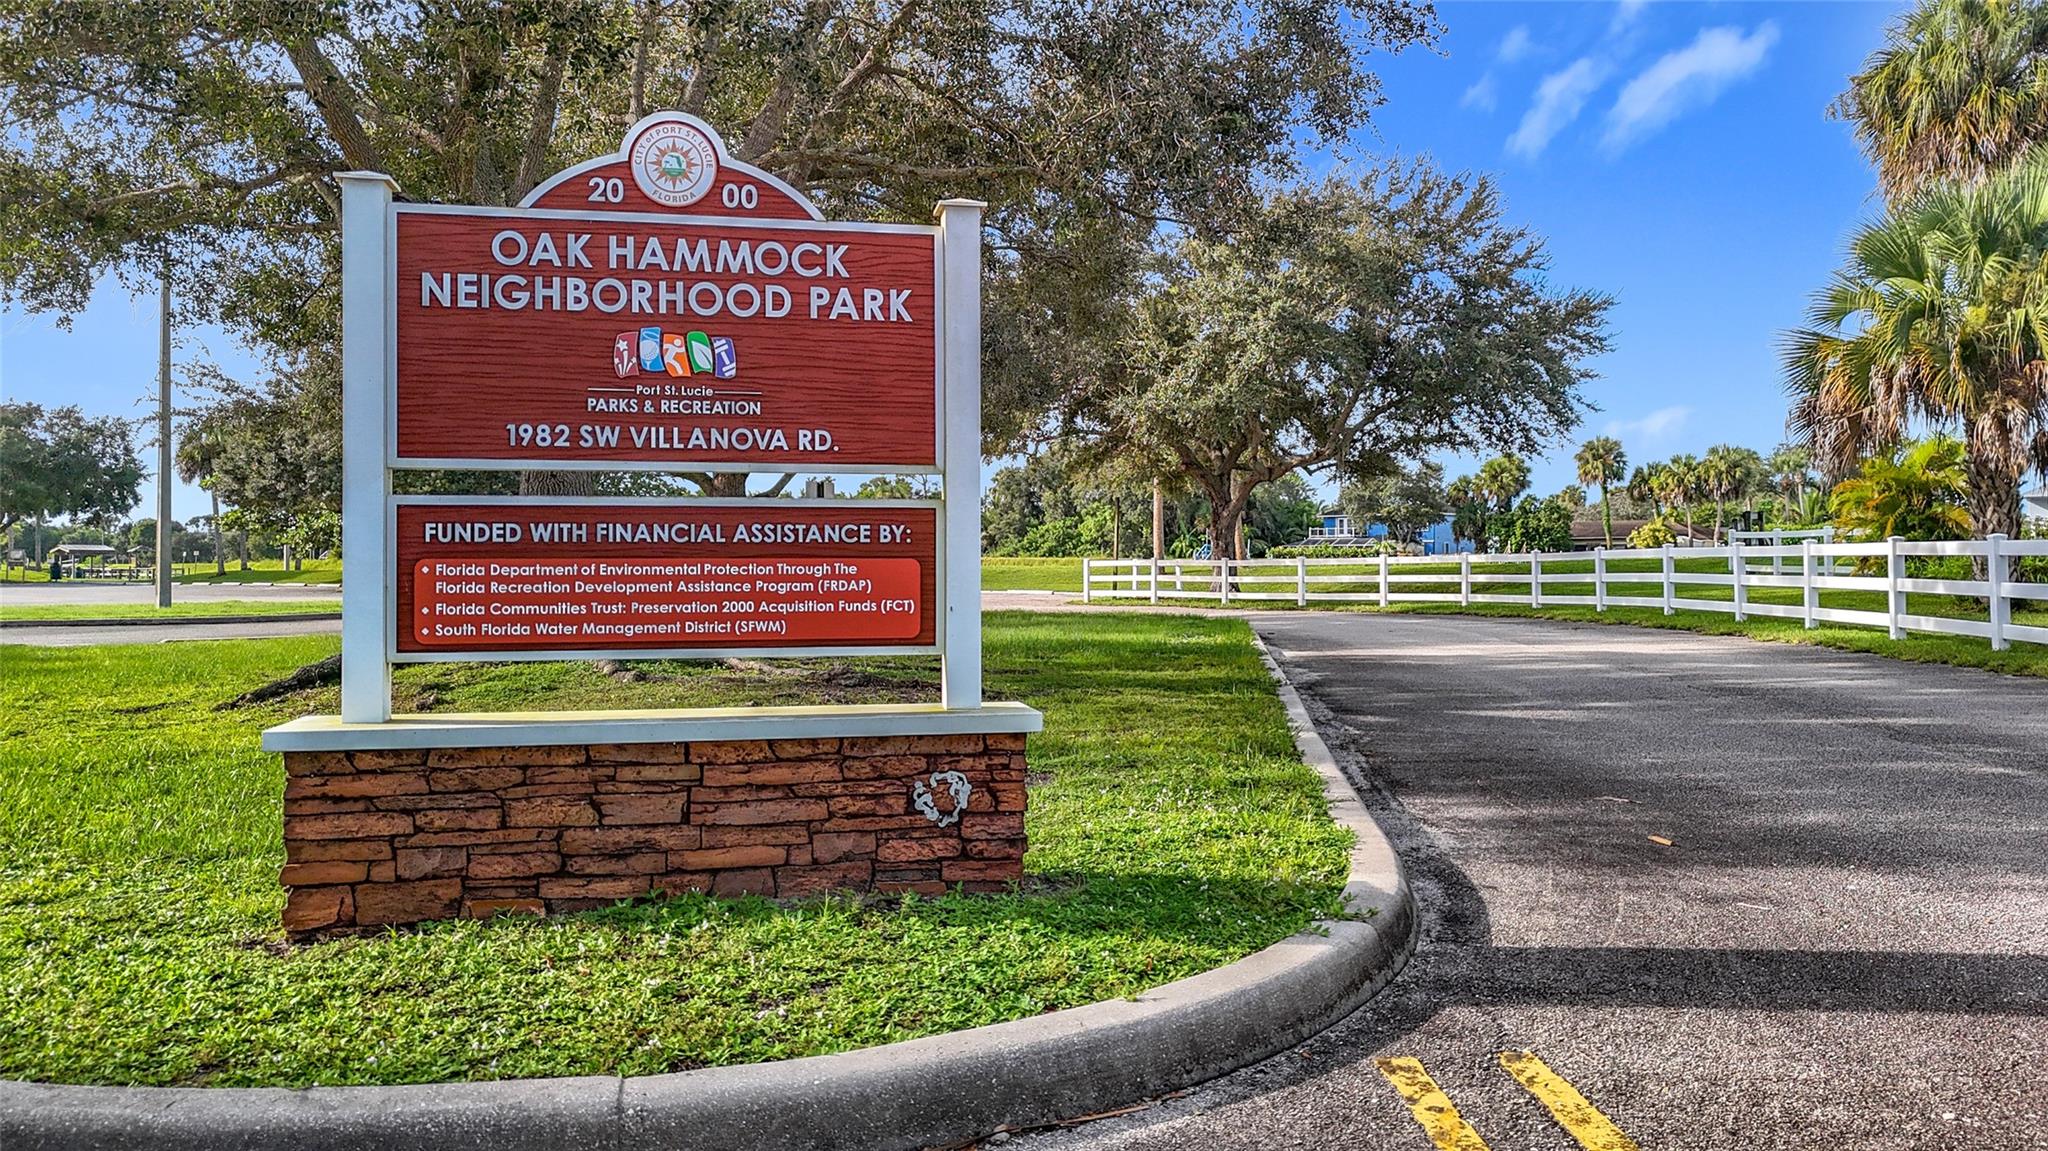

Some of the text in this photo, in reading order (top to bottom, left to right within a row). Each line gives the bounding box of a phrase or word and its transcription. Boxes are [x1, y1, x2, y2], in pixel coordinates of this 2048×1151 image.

[634, 126, 713, 168] CITY of PORT ST. LUCIE
[588, 177, 758, 209] 20 00
[652, 190, 697, 203] FLORIDA
[491, 230, 850, 278] OAK HAMMOCK
[421, 272, 913, 322] NEIGHBORHOOD PARK
[636, 384, 713, 397] Port St. Lucie
[588, 398, 761, 415] PARKS & RECREATION
[506, 424, 839, 451] 1982 SW VILLANOVA RD.
[424, 523, 912, 543] FUNDED WITH FINANCIAL ASSISTANCE BY:
[436, 563, 857, 578] Florida Department of Environmental Protection Through The
[436, 580, 871, 595] Florida Recreation Development Assistance Program (FRDAP)
[436, 600, 914, 615] Florida Communities Trust: Preservation 2000 Acquisition Funds (FCT)
[436, 620, 786, 636] South Florida Water Management District (SFWM)
